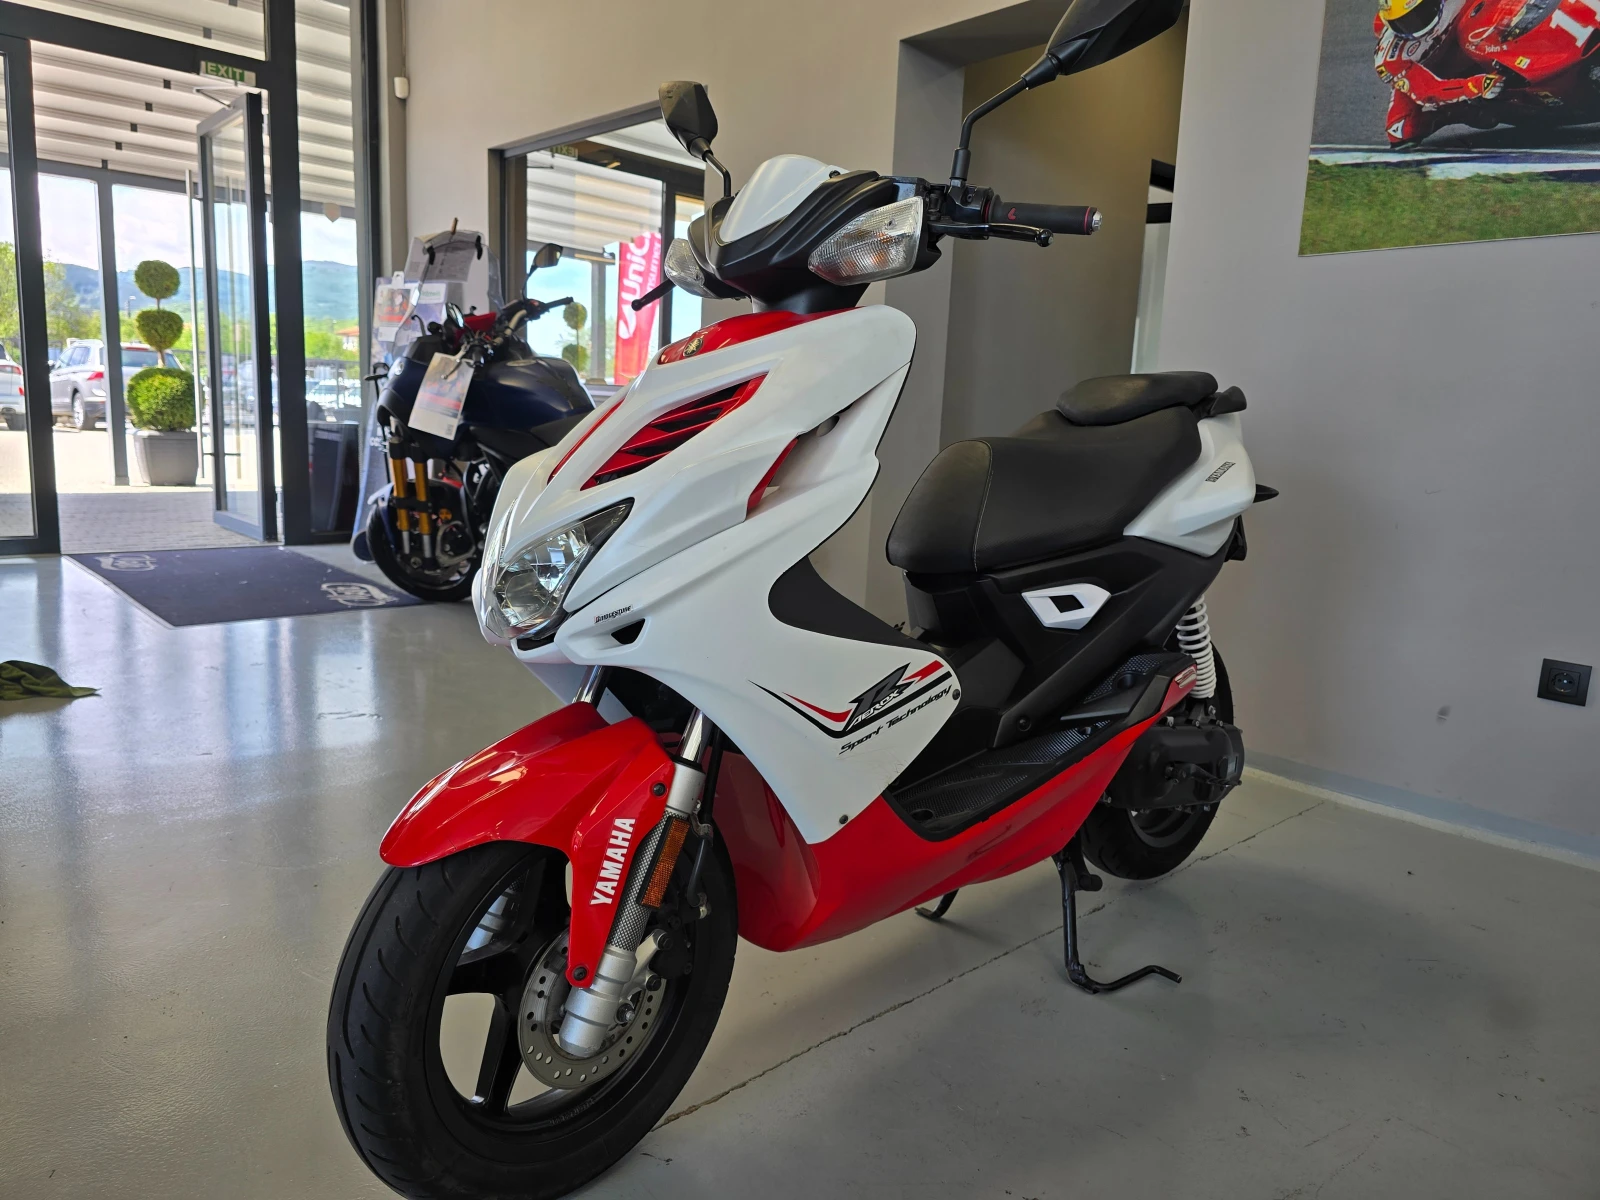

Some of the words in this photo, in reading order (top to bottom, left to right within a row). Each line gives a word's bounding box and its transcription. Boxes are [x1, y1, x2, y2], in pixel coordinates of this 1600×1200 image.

[207, 61, 243, 81] EXIT
[621, 231, 652, 302] UniC
[839, 725, 884, 755] Sport
[886, 684, 952, 729] Technology
[590, 818, 636, 905] YAMAHA
